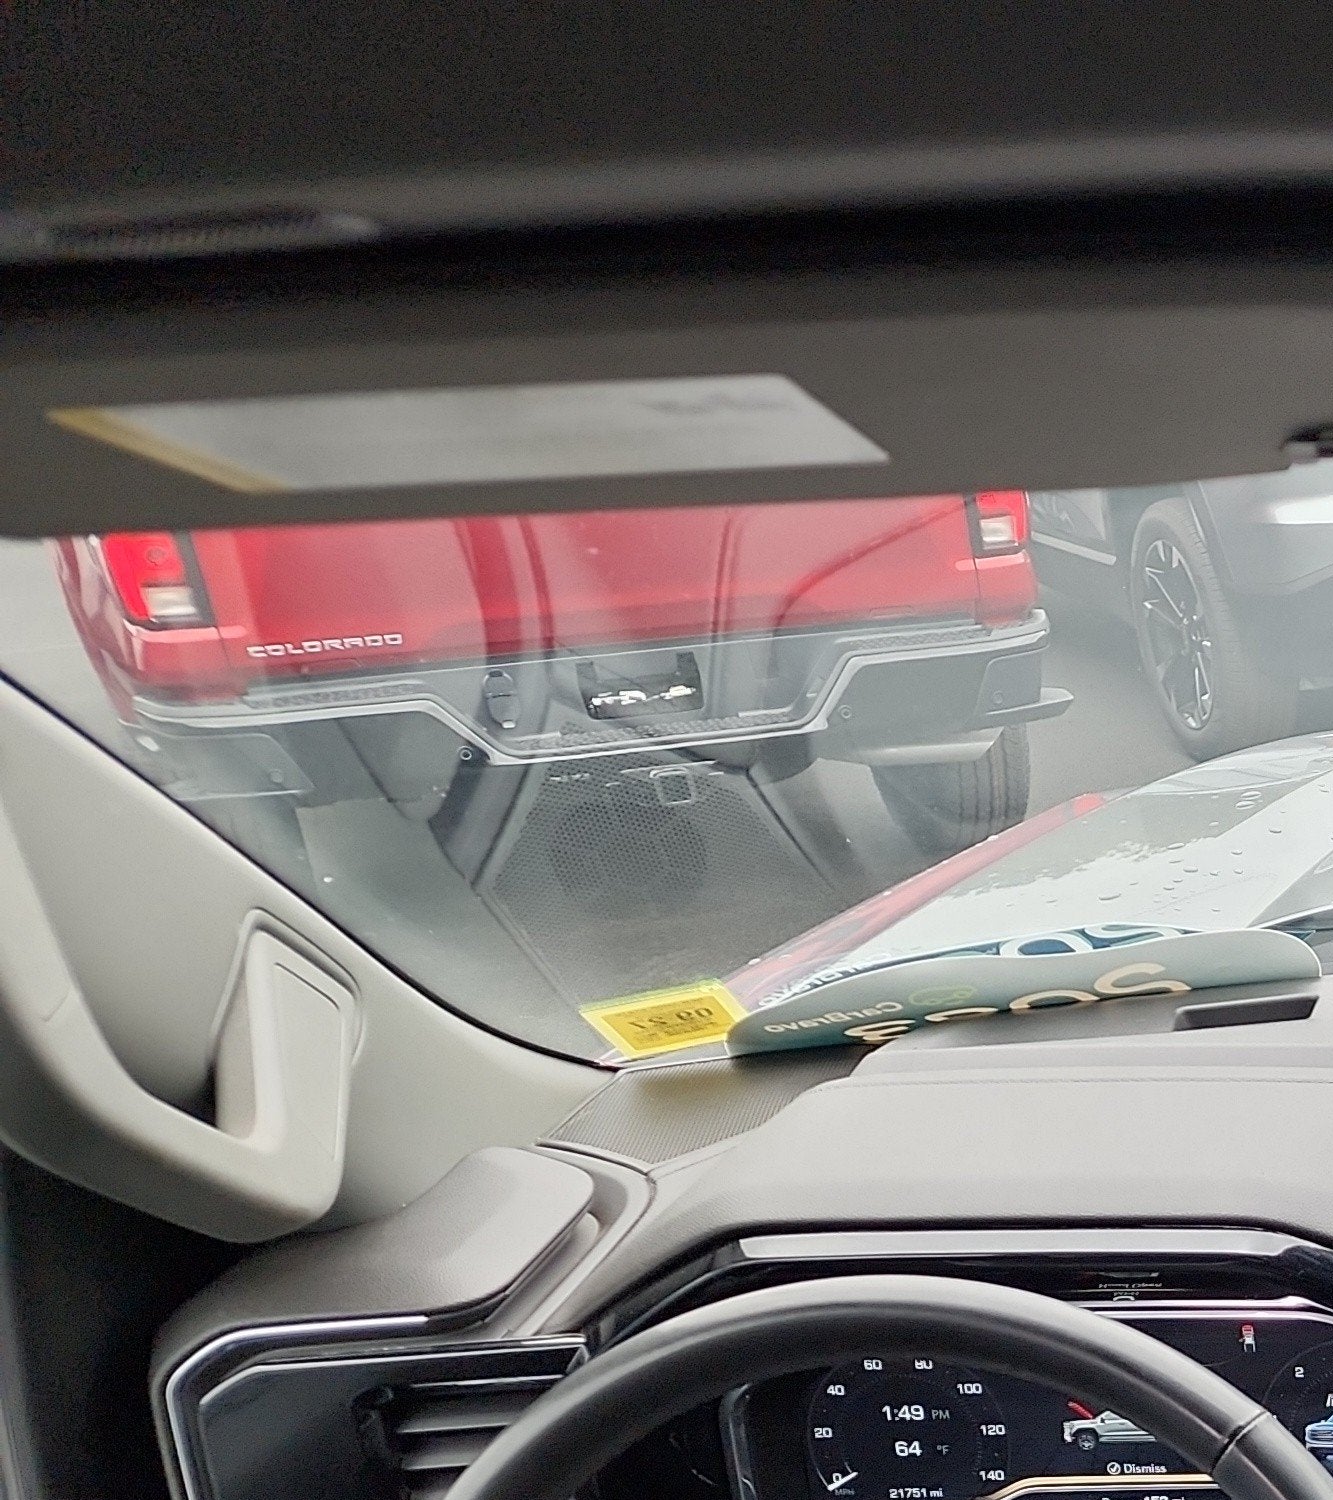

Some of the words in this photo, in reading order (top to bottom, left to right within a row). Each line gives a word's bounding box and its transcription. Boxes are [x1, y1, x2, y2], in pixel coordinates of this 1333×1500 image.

[246, 633, 403, 658] COLORADO
[863, 1359, 883, 1371] 60
[1294, 1366, 1305, 1378] 2
[826, 1384, 846, 1396] 40
[956, 1383, 983, 1395] 100
[881, 1404, 925, 1421] 1:49
[931, 1409, 951, 1420] PM
[813, 1427, 833, 1439] 20
[979, 1424, 1006, 1436] 120
[894, 1440, 923, 1457] 64
[1123, 1463, 1168, 1474] Dismiss
[979, 1470, 1005, 1481] 140
[889, 1488, 928, 1499] 21751
[929, 1488, 943, 1498] mi
